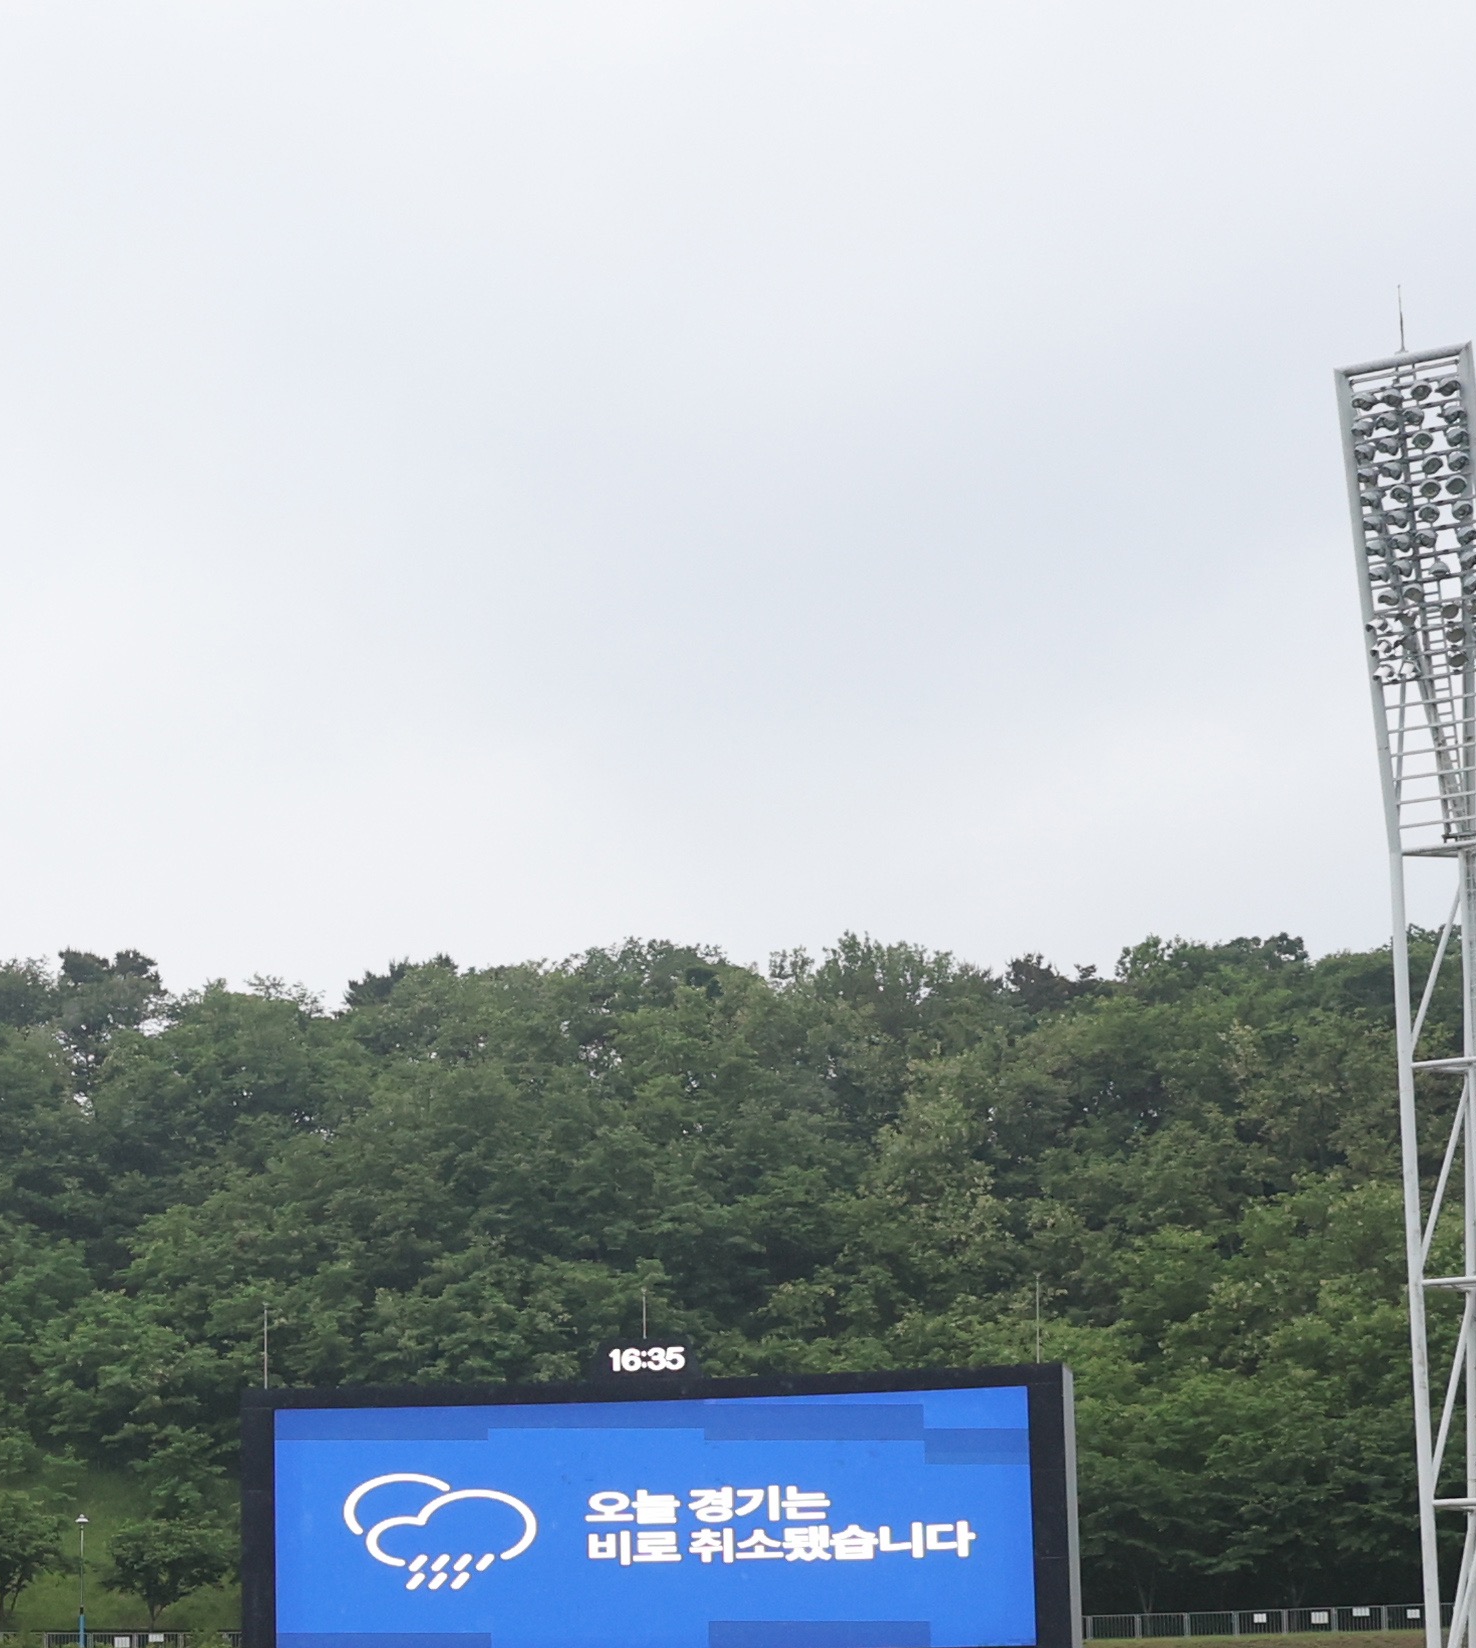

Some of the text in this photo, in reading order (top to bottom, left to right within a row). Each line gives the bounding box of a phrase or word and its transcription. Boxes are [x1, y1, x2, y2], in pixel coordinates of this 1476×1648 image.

[608, 1346, 686, 1372] 16:35
[584, 1485, 832, 1525] 오늘 경기는
[586, 1520, 977, 1566] 비로 취소됐습니다
